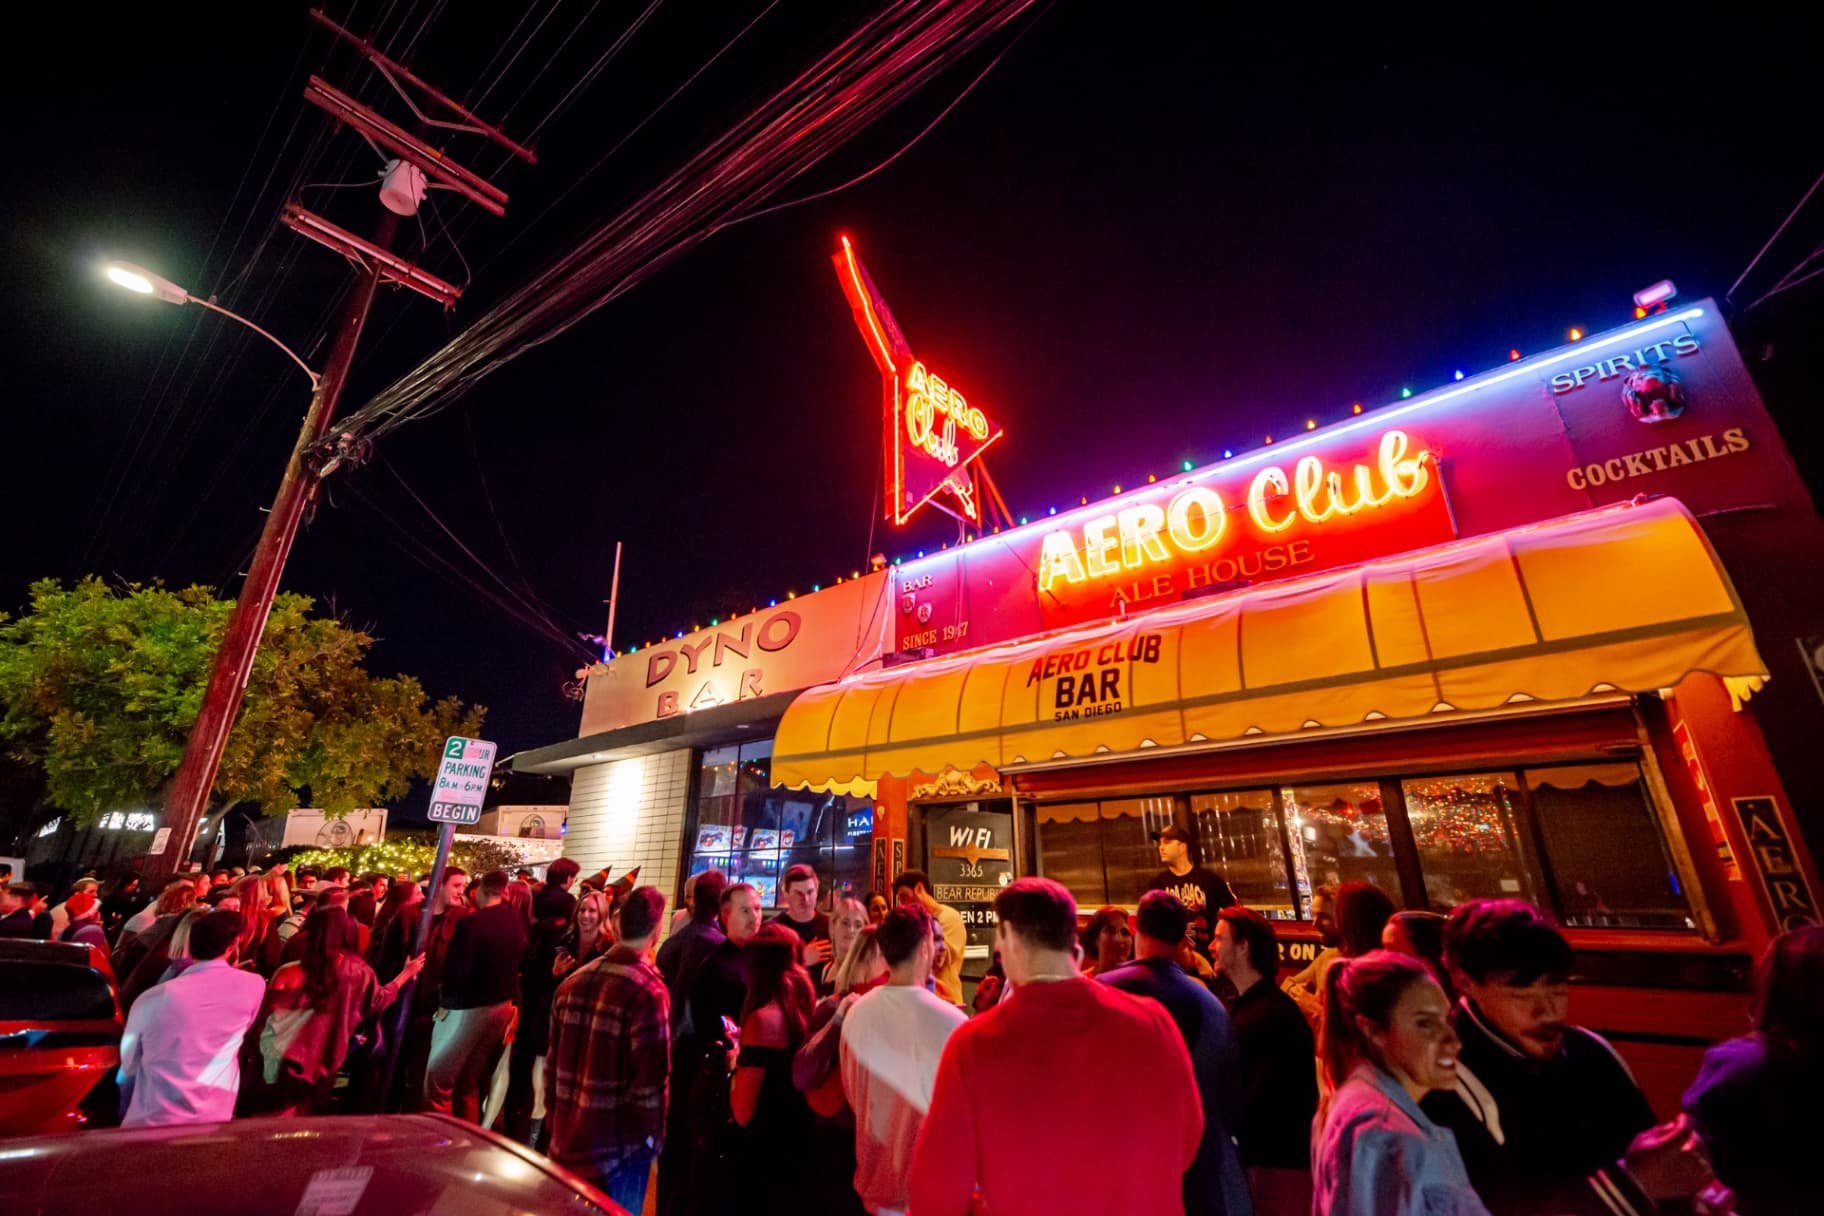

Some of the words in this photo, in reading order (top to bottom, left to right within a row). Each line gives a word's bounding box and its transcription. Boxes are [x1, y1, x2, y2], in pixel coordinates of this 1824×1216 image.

[1551, 333, 1700, 395] SPIRITS
[906, 361, 988, 440] AERO
[906, 393, 959, 468] Club
[1566, 428, 1750, 491] COCKTAILS
[1037, 487, 1227, 592] AERO
[1247, 430, 1432, 532] Club
[903, 575, 933, 594] BAR
[1108, 574, 1174, 608] ALE
[1188, 540, 1316, 588] HOUSE
[646, 610, 801, 688] DYNO
[903, 629, 937, 650] SINCE
[1027, 649, 1090, 688] AERO
[1097, 634, 1162, 666] CLUB
[657, 668, 765, 719] BAR
[1055, 668, 1121, 710] BAR
[1054, 708, 1080, 723] SAN
[1084, 701, 1123, 719] DIEGO
[448, 740, 462, 756] 2
[444, 761, 486, 779] PARKING
[433, 803, 477, 820] BEGIN
[959, 864, 984, 878] 3365
[936, 886, 962, 900] BEAR
[976, 910, 984, 924] 2
[1290, 942, 1316, 961] ON
